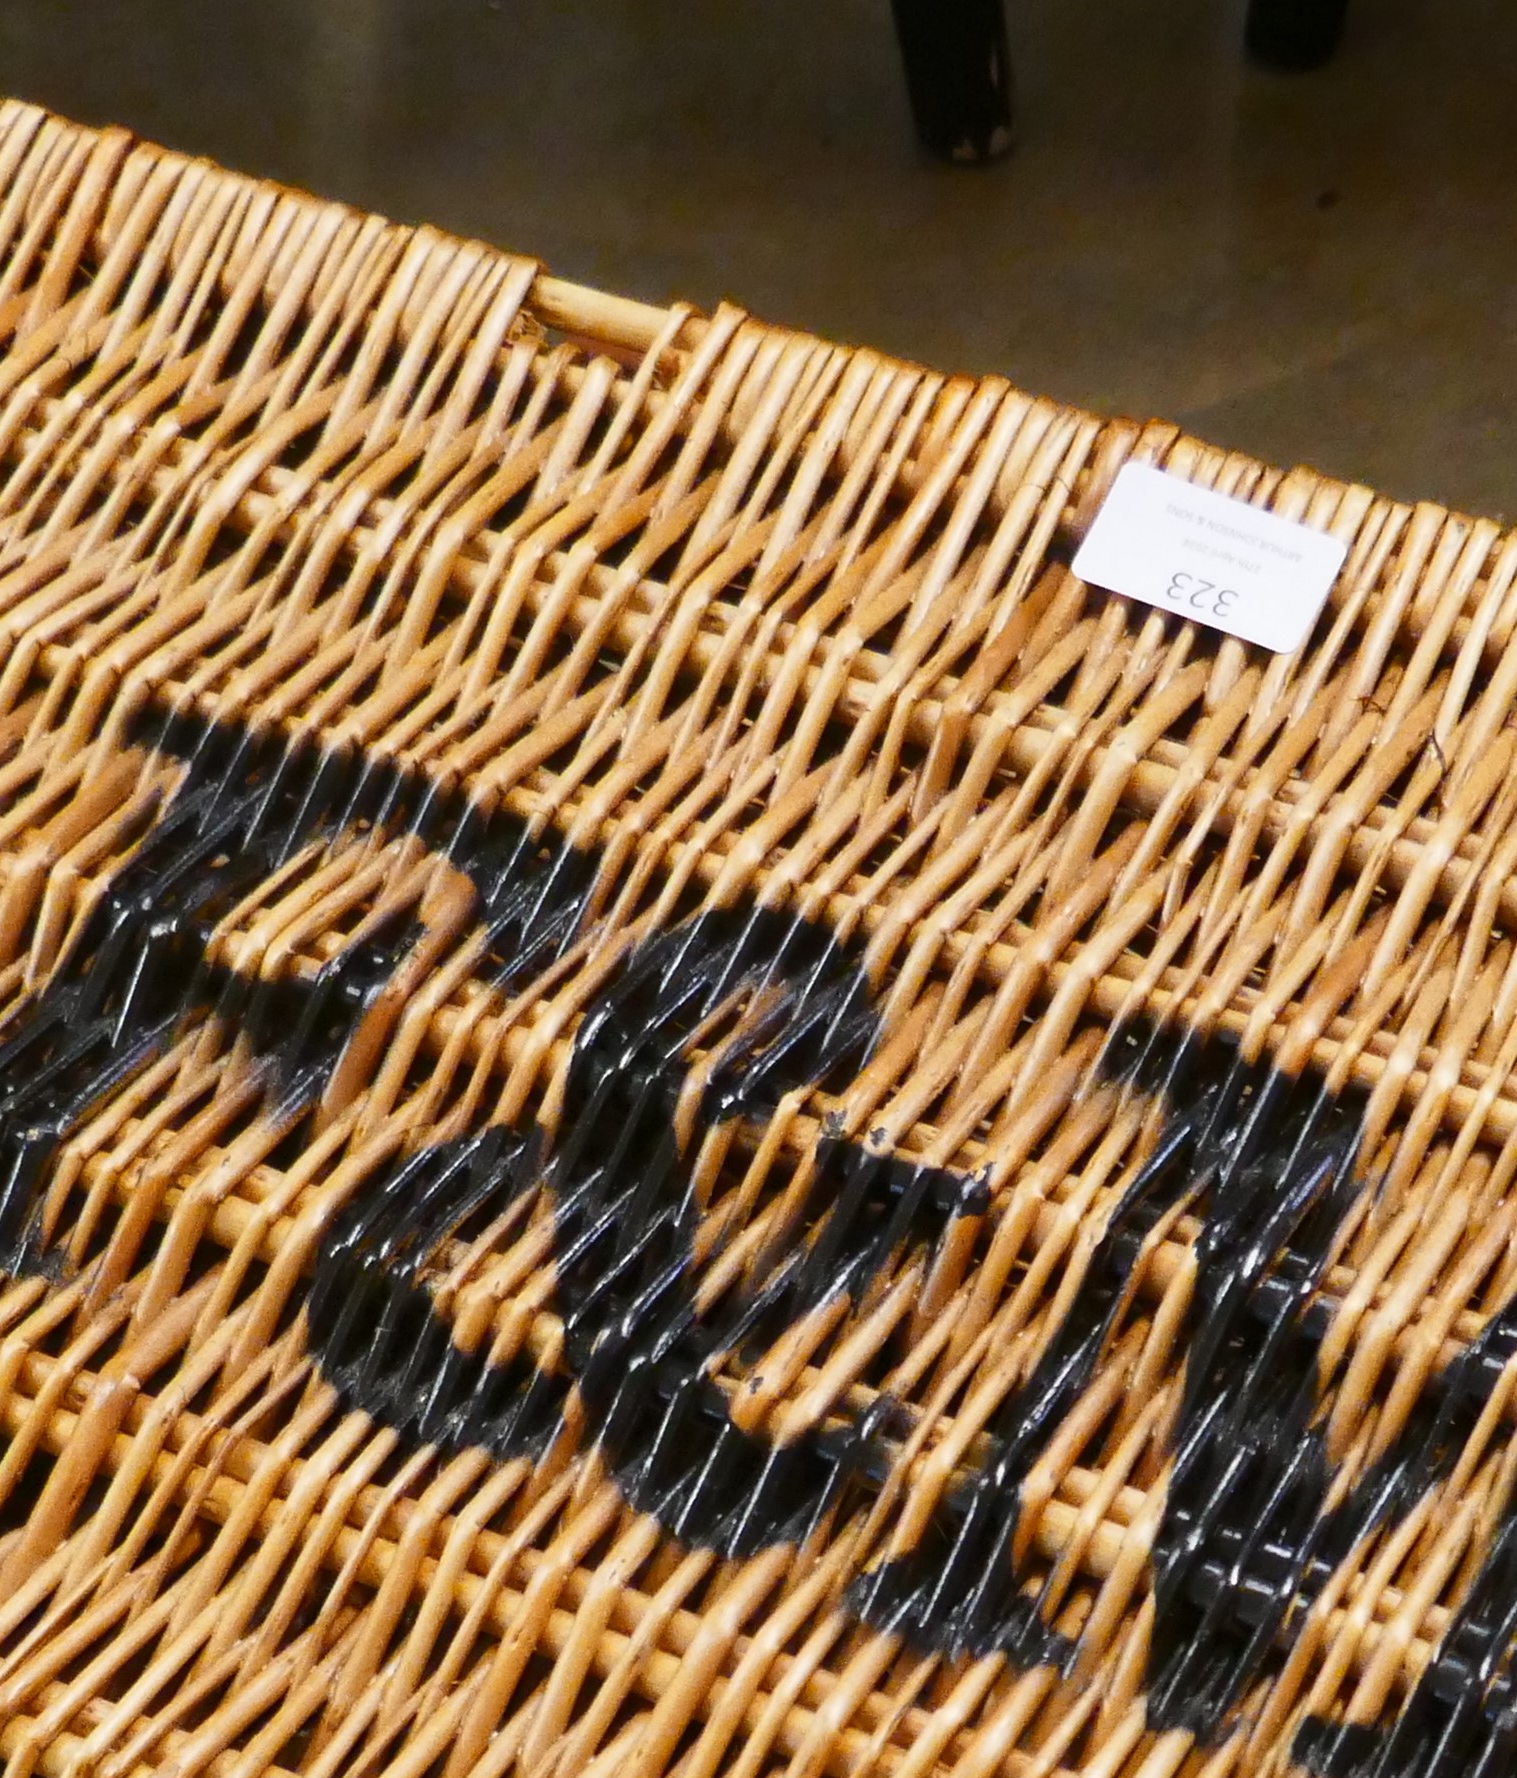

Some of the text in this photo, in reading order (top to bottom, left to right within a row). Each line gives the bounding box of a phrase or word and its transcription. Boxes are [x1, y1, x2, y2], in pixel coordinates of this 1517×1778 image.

[1208, 519, 1257, 549] JOHNSON
[1259, 539, 1303, 563] ARTHUR
[1166, 572, 1239, 617] 323
